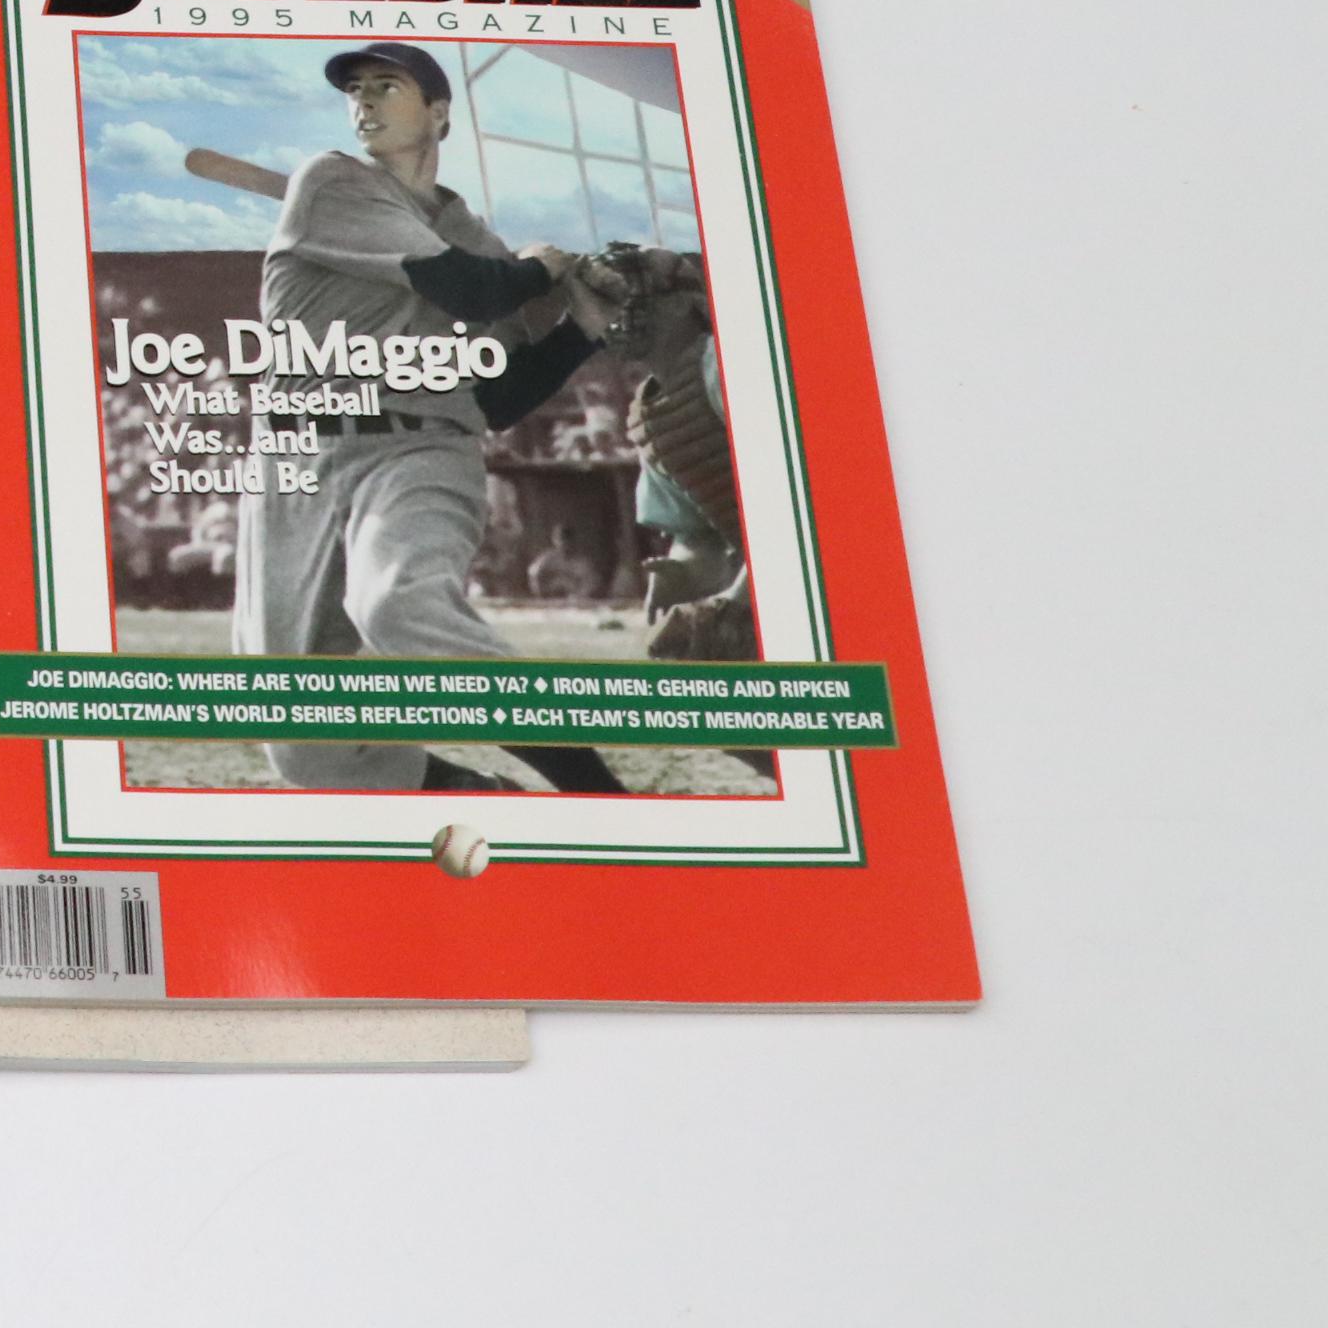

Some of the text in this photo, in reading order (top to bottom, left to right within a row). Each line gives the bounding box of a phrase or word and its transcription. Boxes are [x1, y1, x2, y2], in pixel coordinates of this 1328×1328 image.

[154, 6, 673, 36] 1995 MAGAZINE
[106, 317, 508, 393] Joe DiMaggio
[141, 381, 380, 417] What Baseball
[149, 461, 320, 495] Should Be
[27, 670, 528, 693] JOE DIMAGGIO: WHERE ARE YOU WHEN WE NEED YA?
[553, 678, 850, 697] IRON MEN: GEHRIG AND RIPKEN
[0, 701, 488, 724] JEROME HOLTZMAN'S WORLD SERIES REFLECTIONS
[512, 708, 884, 729] EACH TEAM'S MOST MEMORABLE YEAR
[38, 874, 77, 884] $4.99
[121, 887, 141, 899] 55
